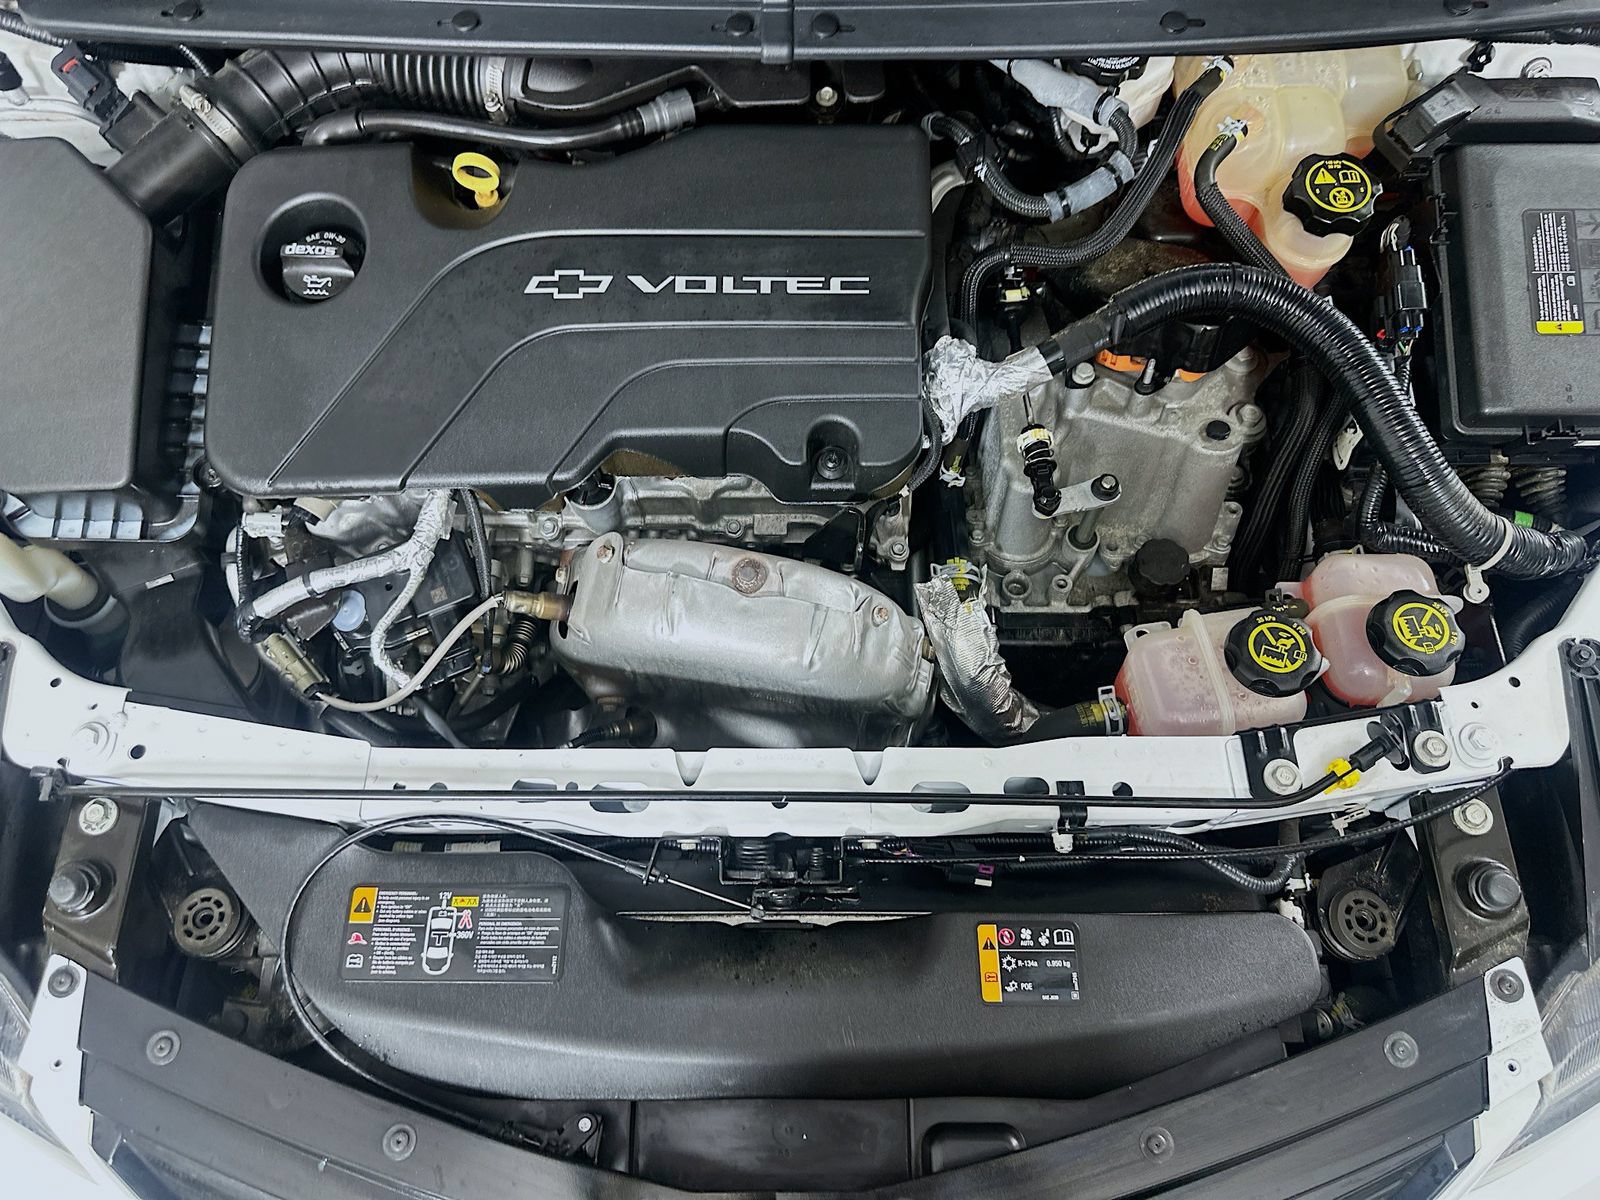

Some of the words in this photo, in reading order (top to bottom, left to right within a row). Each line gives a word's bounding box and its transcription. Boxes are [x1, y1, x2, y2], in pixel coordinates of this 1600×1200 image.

[306, 232, 320, 243] SAE
[284, 242, 338, 256] dexos
[626, 275, 870, 295] VOLTEC
[1296, 625, 1307, 636] PSI
[439, 891, 453, 899] 12V
[1017, 959, 1038, 967] R-134a
[1062, 959, 1071, 968] kg
[1020, 982, 1033, 990] POE
